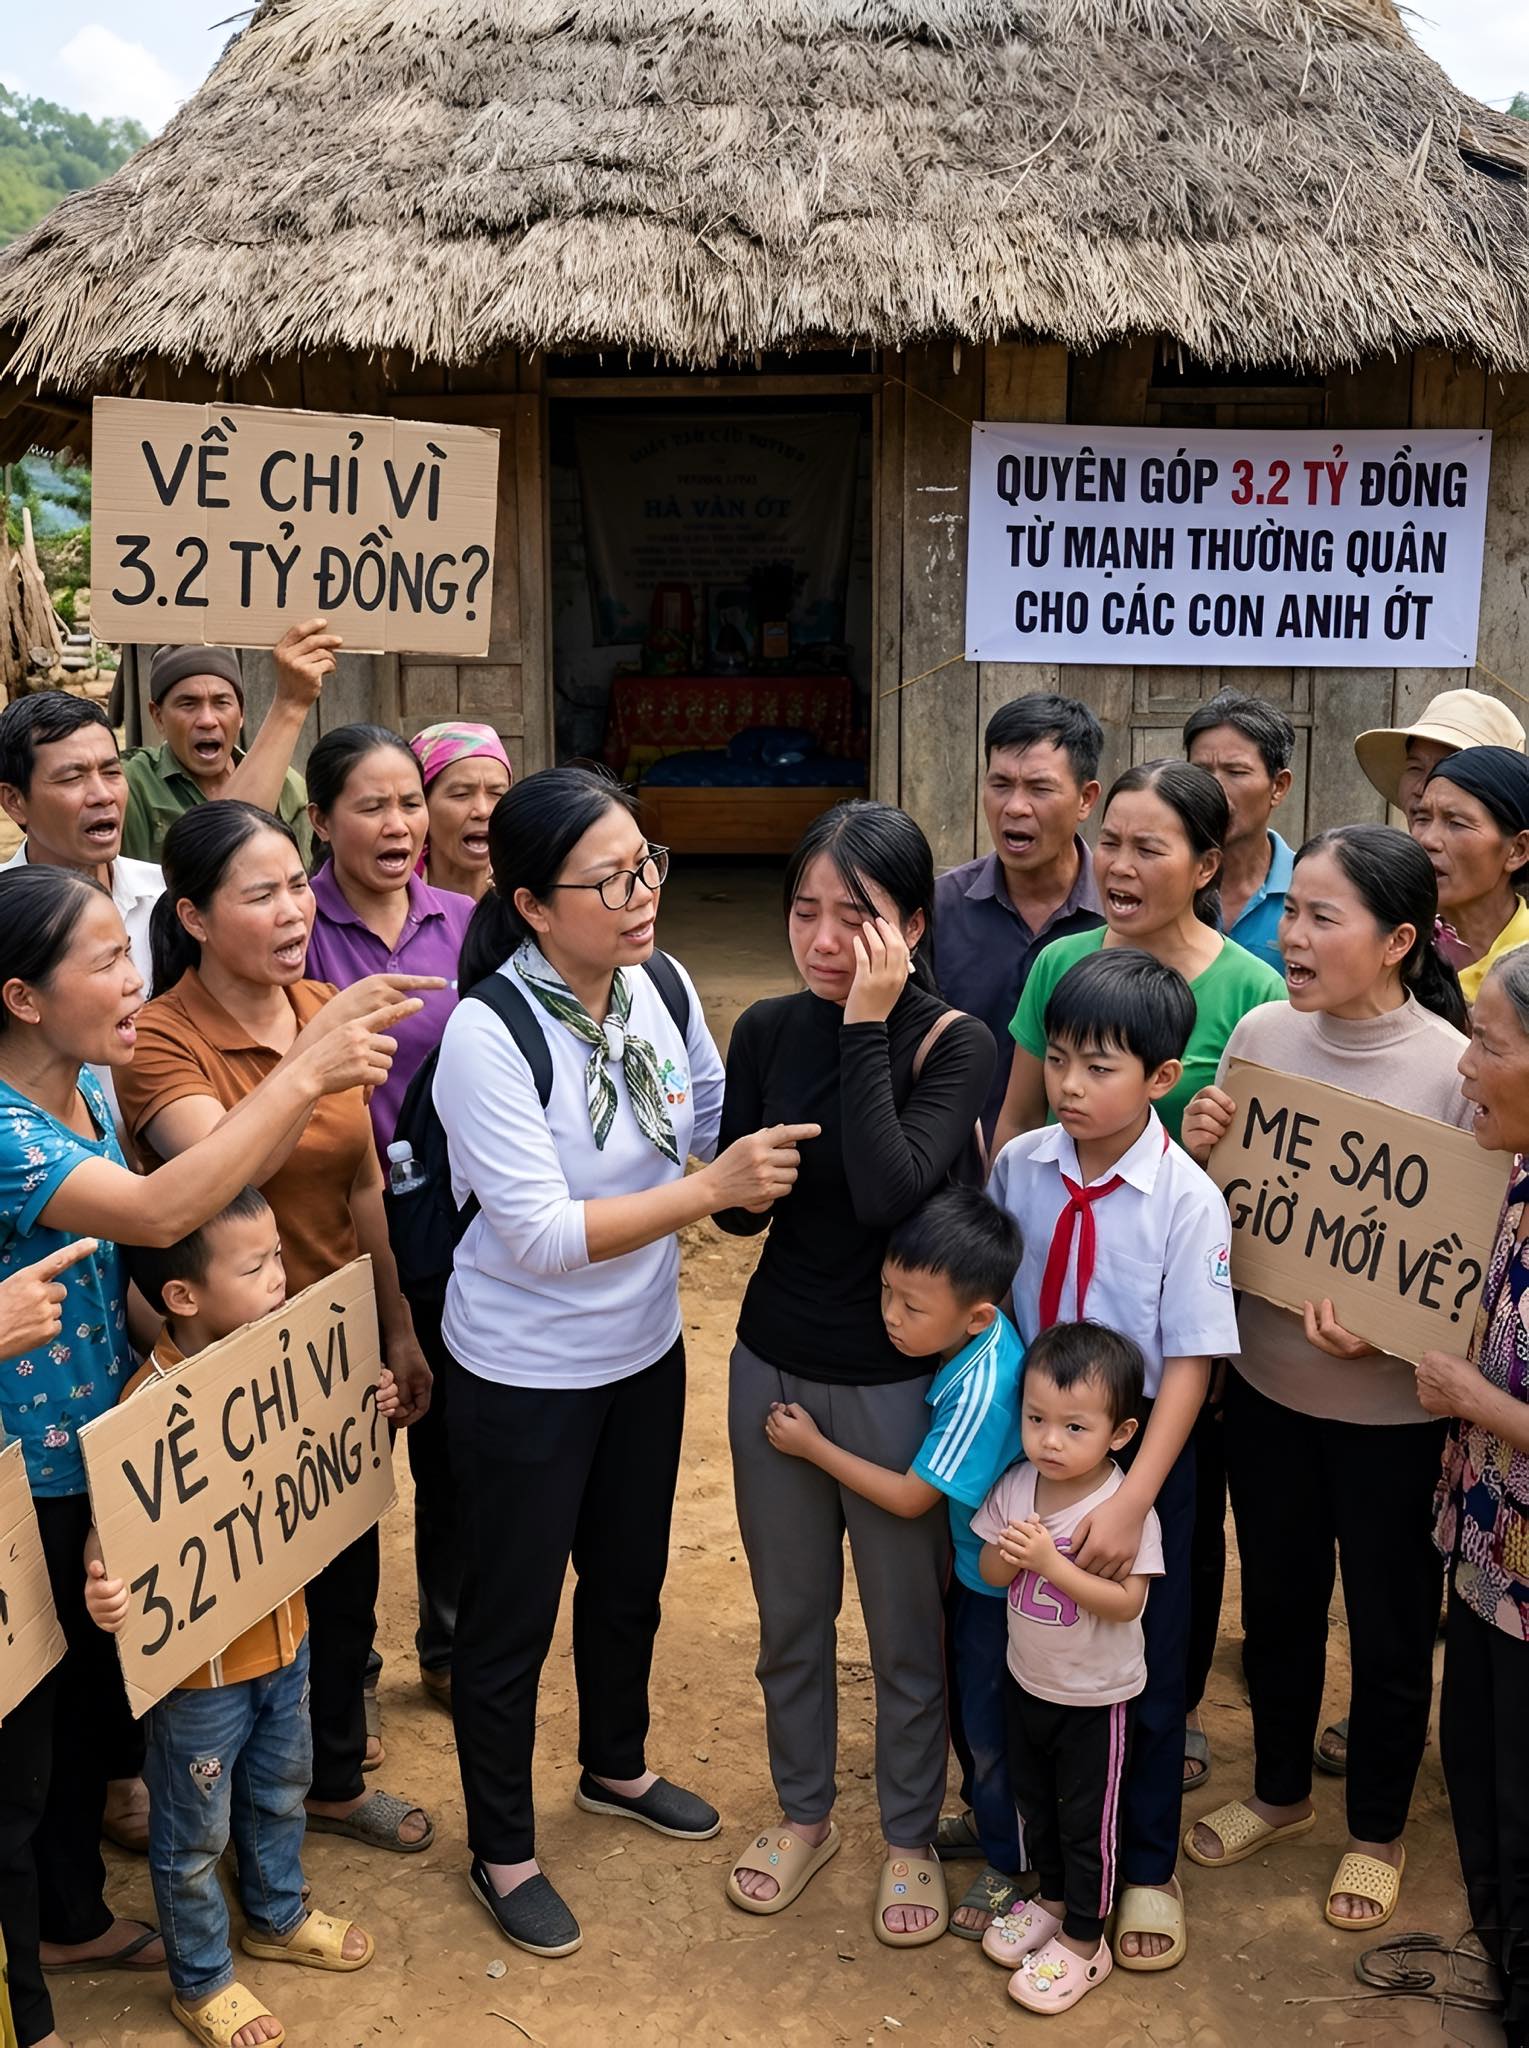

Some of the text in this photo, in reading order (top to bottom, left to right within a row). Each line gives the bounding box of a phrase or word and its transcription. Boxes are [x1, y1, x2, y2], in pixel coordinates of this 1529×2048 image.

[141, 416, 448, 522] VỀ CHỈ VÌ
[996, 443, 1468, 508] QUYÊN GÓP 3.2 TỶ ĐỒNG
[112, 521, 491, 621] 3.2 TỶ ĐỒNG?
[1006, 514, 1447, 579] TỪ MẠNH THƯỜNG QUÂN
[1015, 582, 1434, 641] CHO CÁC CON ANIH ỚT
[1242, 1097, 1429, 1209] MẸ SAO
[1222, 1175, 1482, 1323] GIỜ MỚI VỀ?
[121, 1302, 350, 1523] VỀ CHỈ VÌ
[130, 1536, 217, 1656] 3.2
[213, 1469, 264, 1583] TỶ
[274, 1385, 382, 1544] ĐỒNG?
